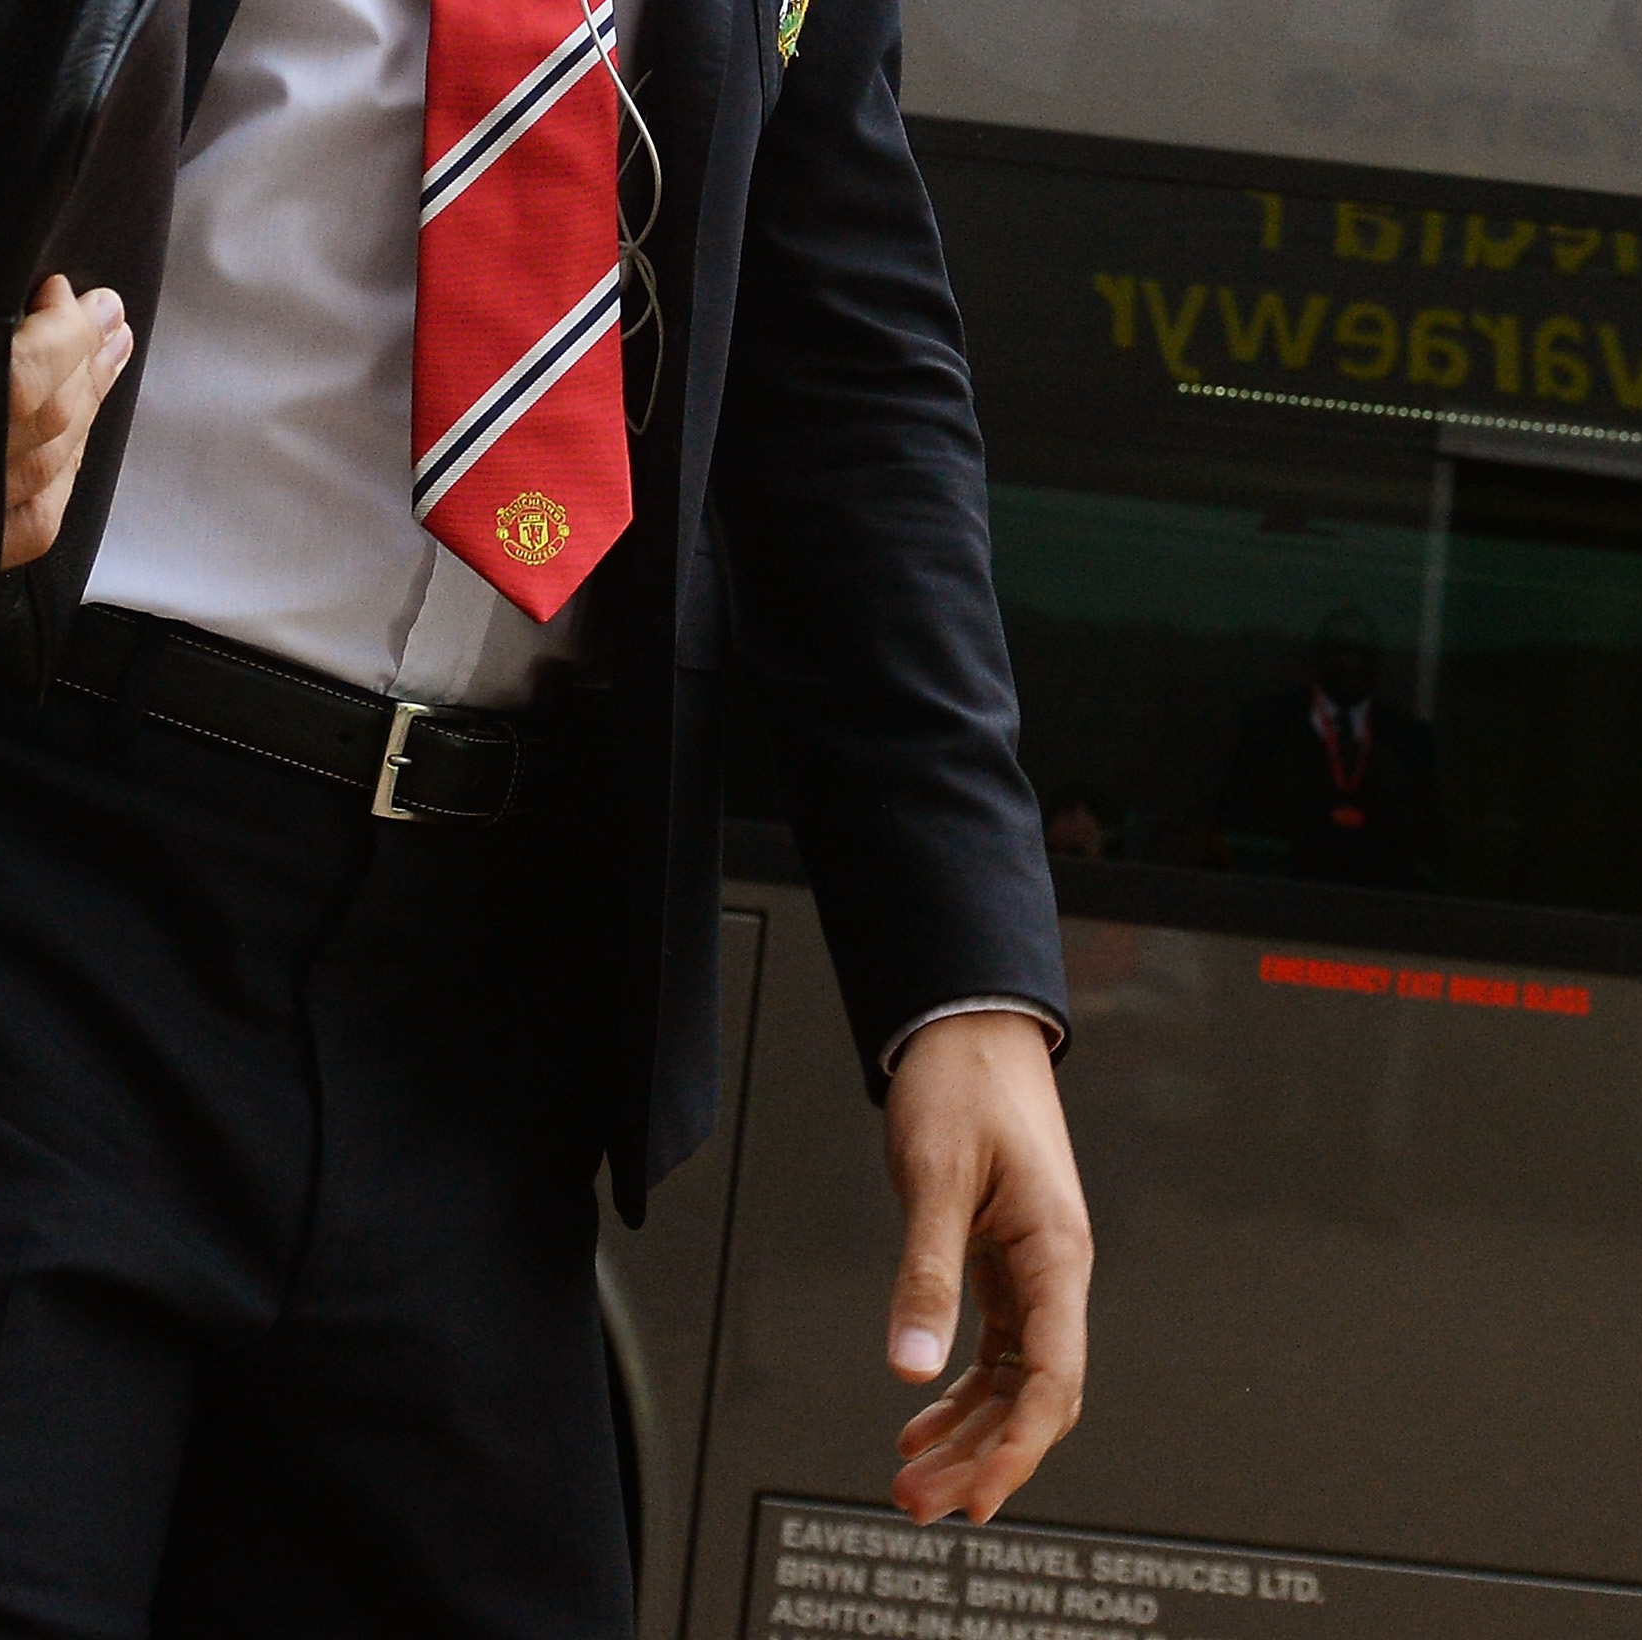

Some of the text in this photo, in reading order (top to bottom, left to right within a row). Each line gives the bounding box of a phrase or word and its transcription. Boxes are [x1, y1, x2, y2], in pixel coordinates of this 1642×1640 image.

[775, 1556, 865, 1594] BRYN
[965, 1577, 1057, 1614] BRYN
[1063, 1589, 1158, 1624] ROAD
[780, 1516, 956, 1565] EAVESWAY
[965, 1539, 1082, 1579] TRAVEL
[1090, 1553, 1250, 1596] SERVICES
